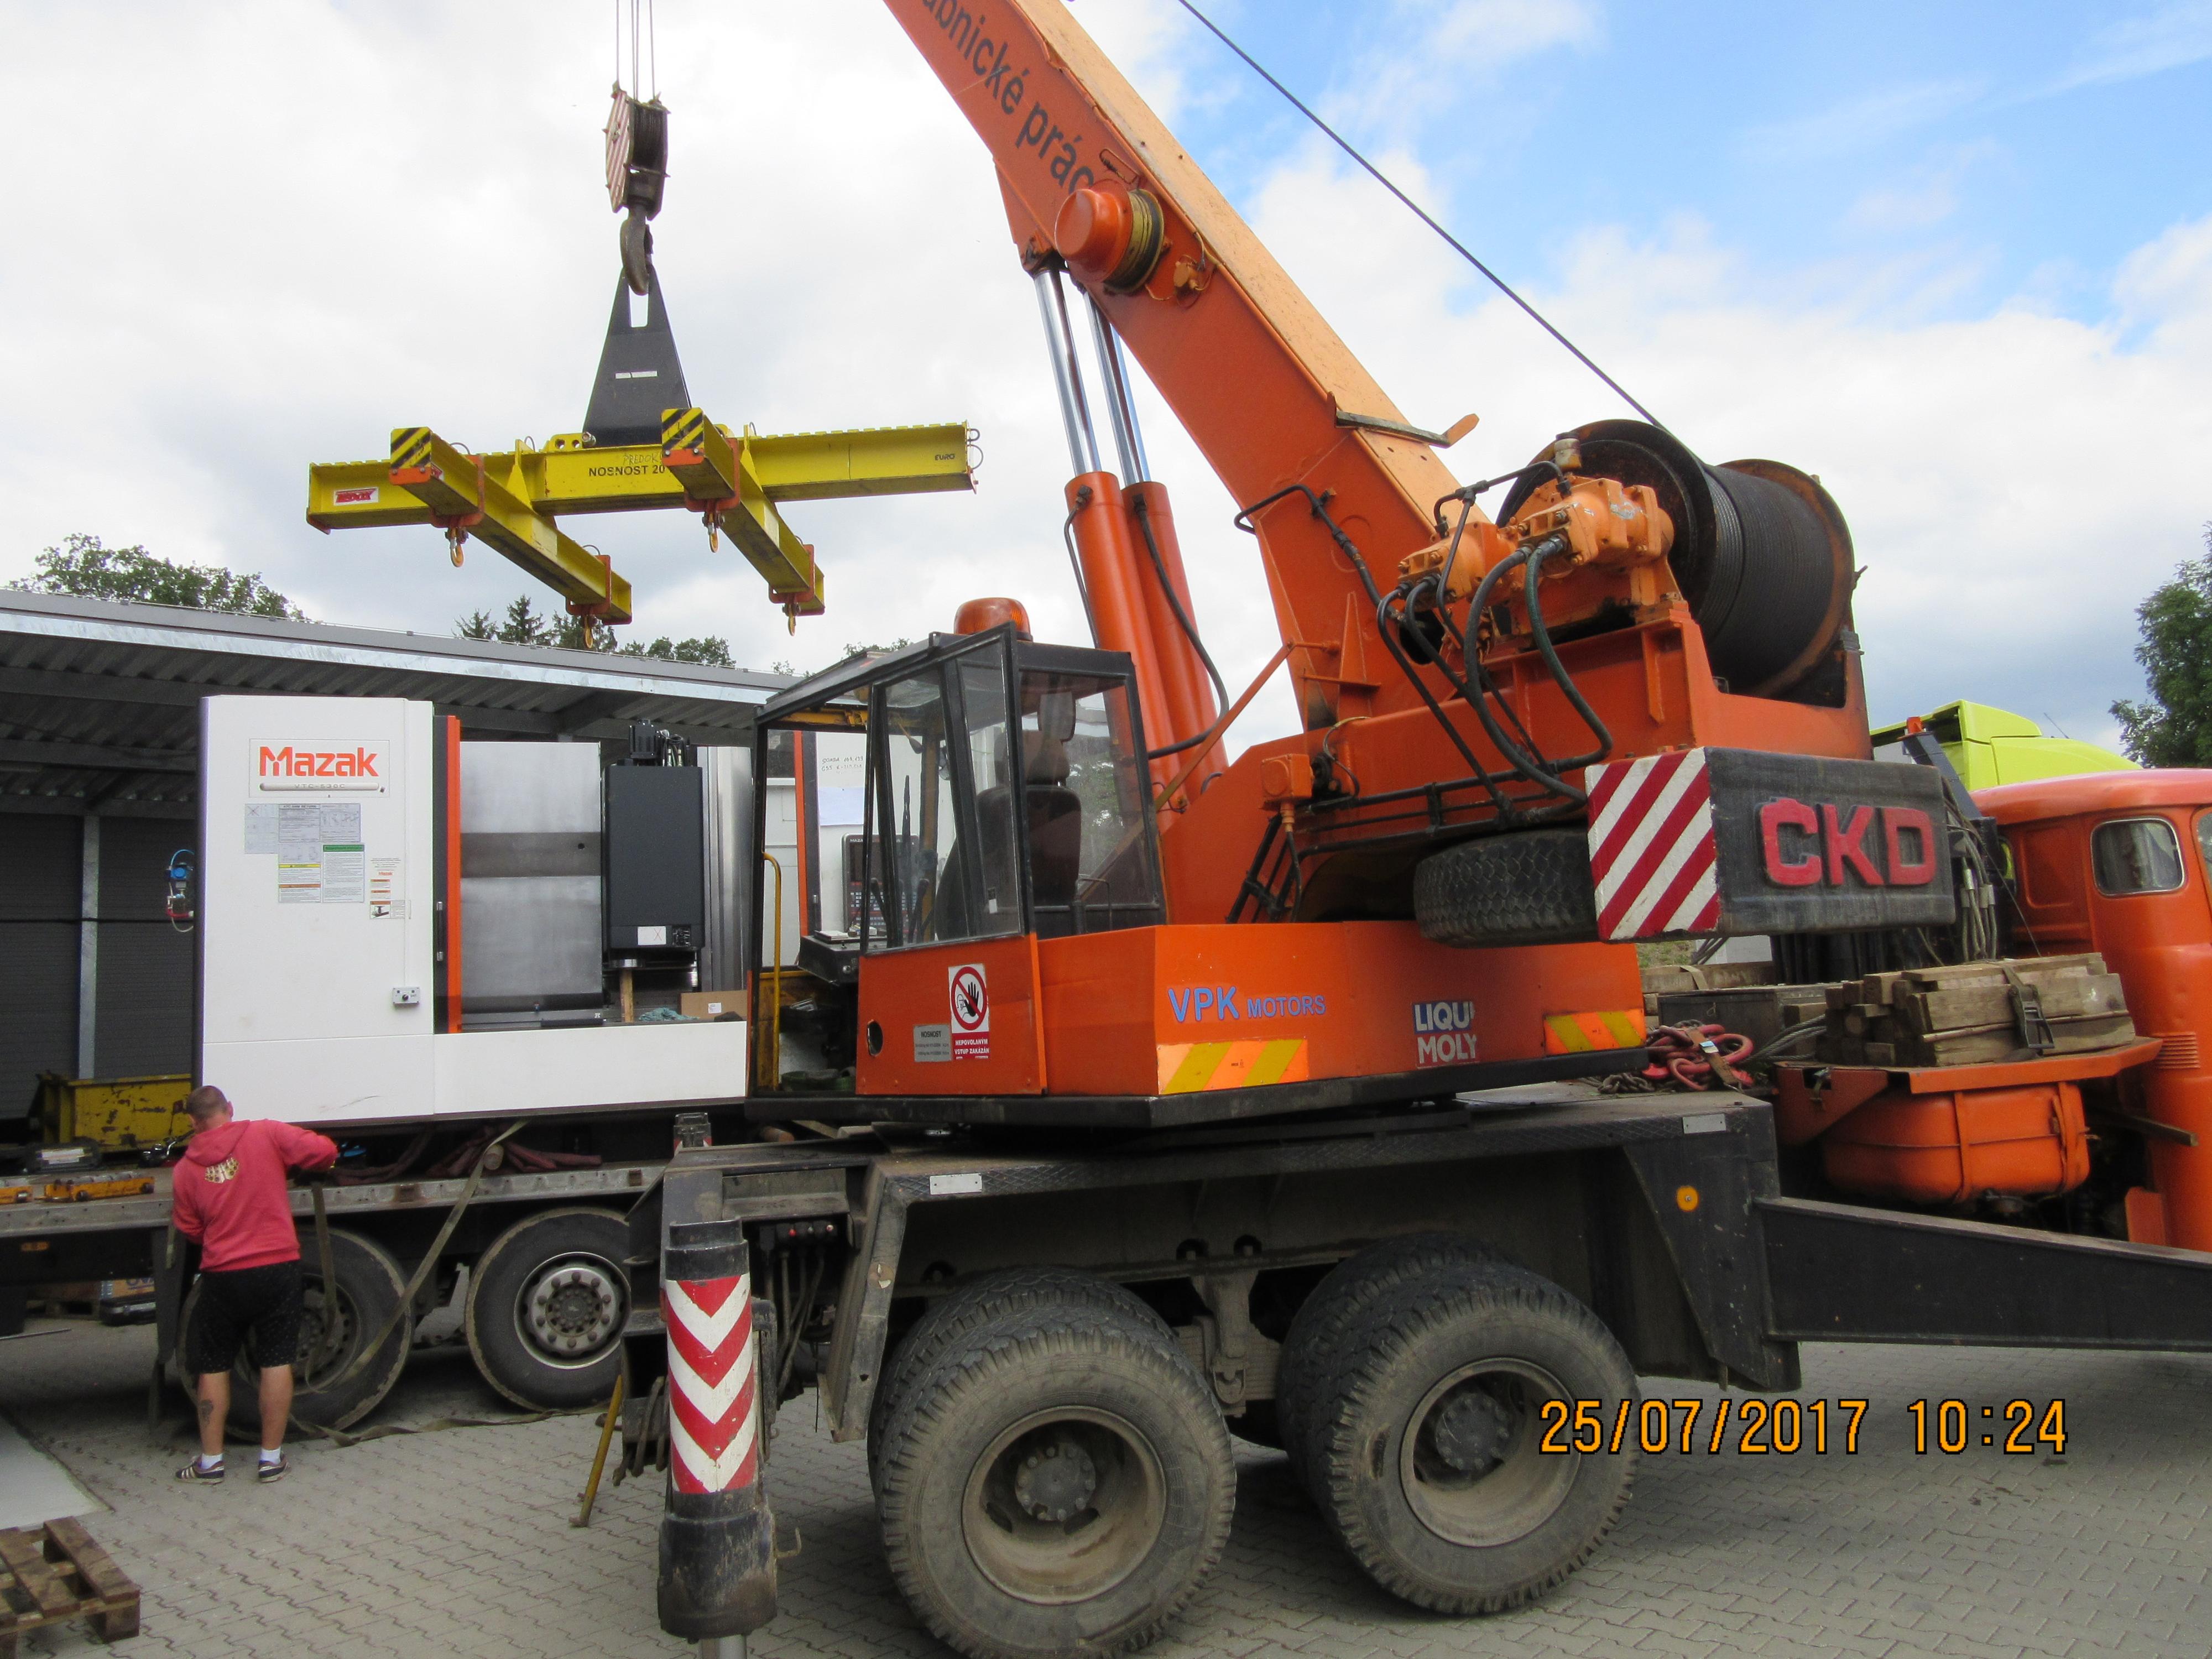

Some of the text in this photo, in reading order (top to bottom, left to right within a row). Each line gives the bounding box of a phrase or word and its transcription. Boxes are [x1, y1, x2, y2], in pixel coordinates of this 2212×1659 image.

[589, 465, 648, 476] NOSNOST
[259, 747, 379, 776] Mazak
[1168, 986, 1326, 1022] VPK MOTORS
[1417, 1034, 1478, 1064] MOLY
